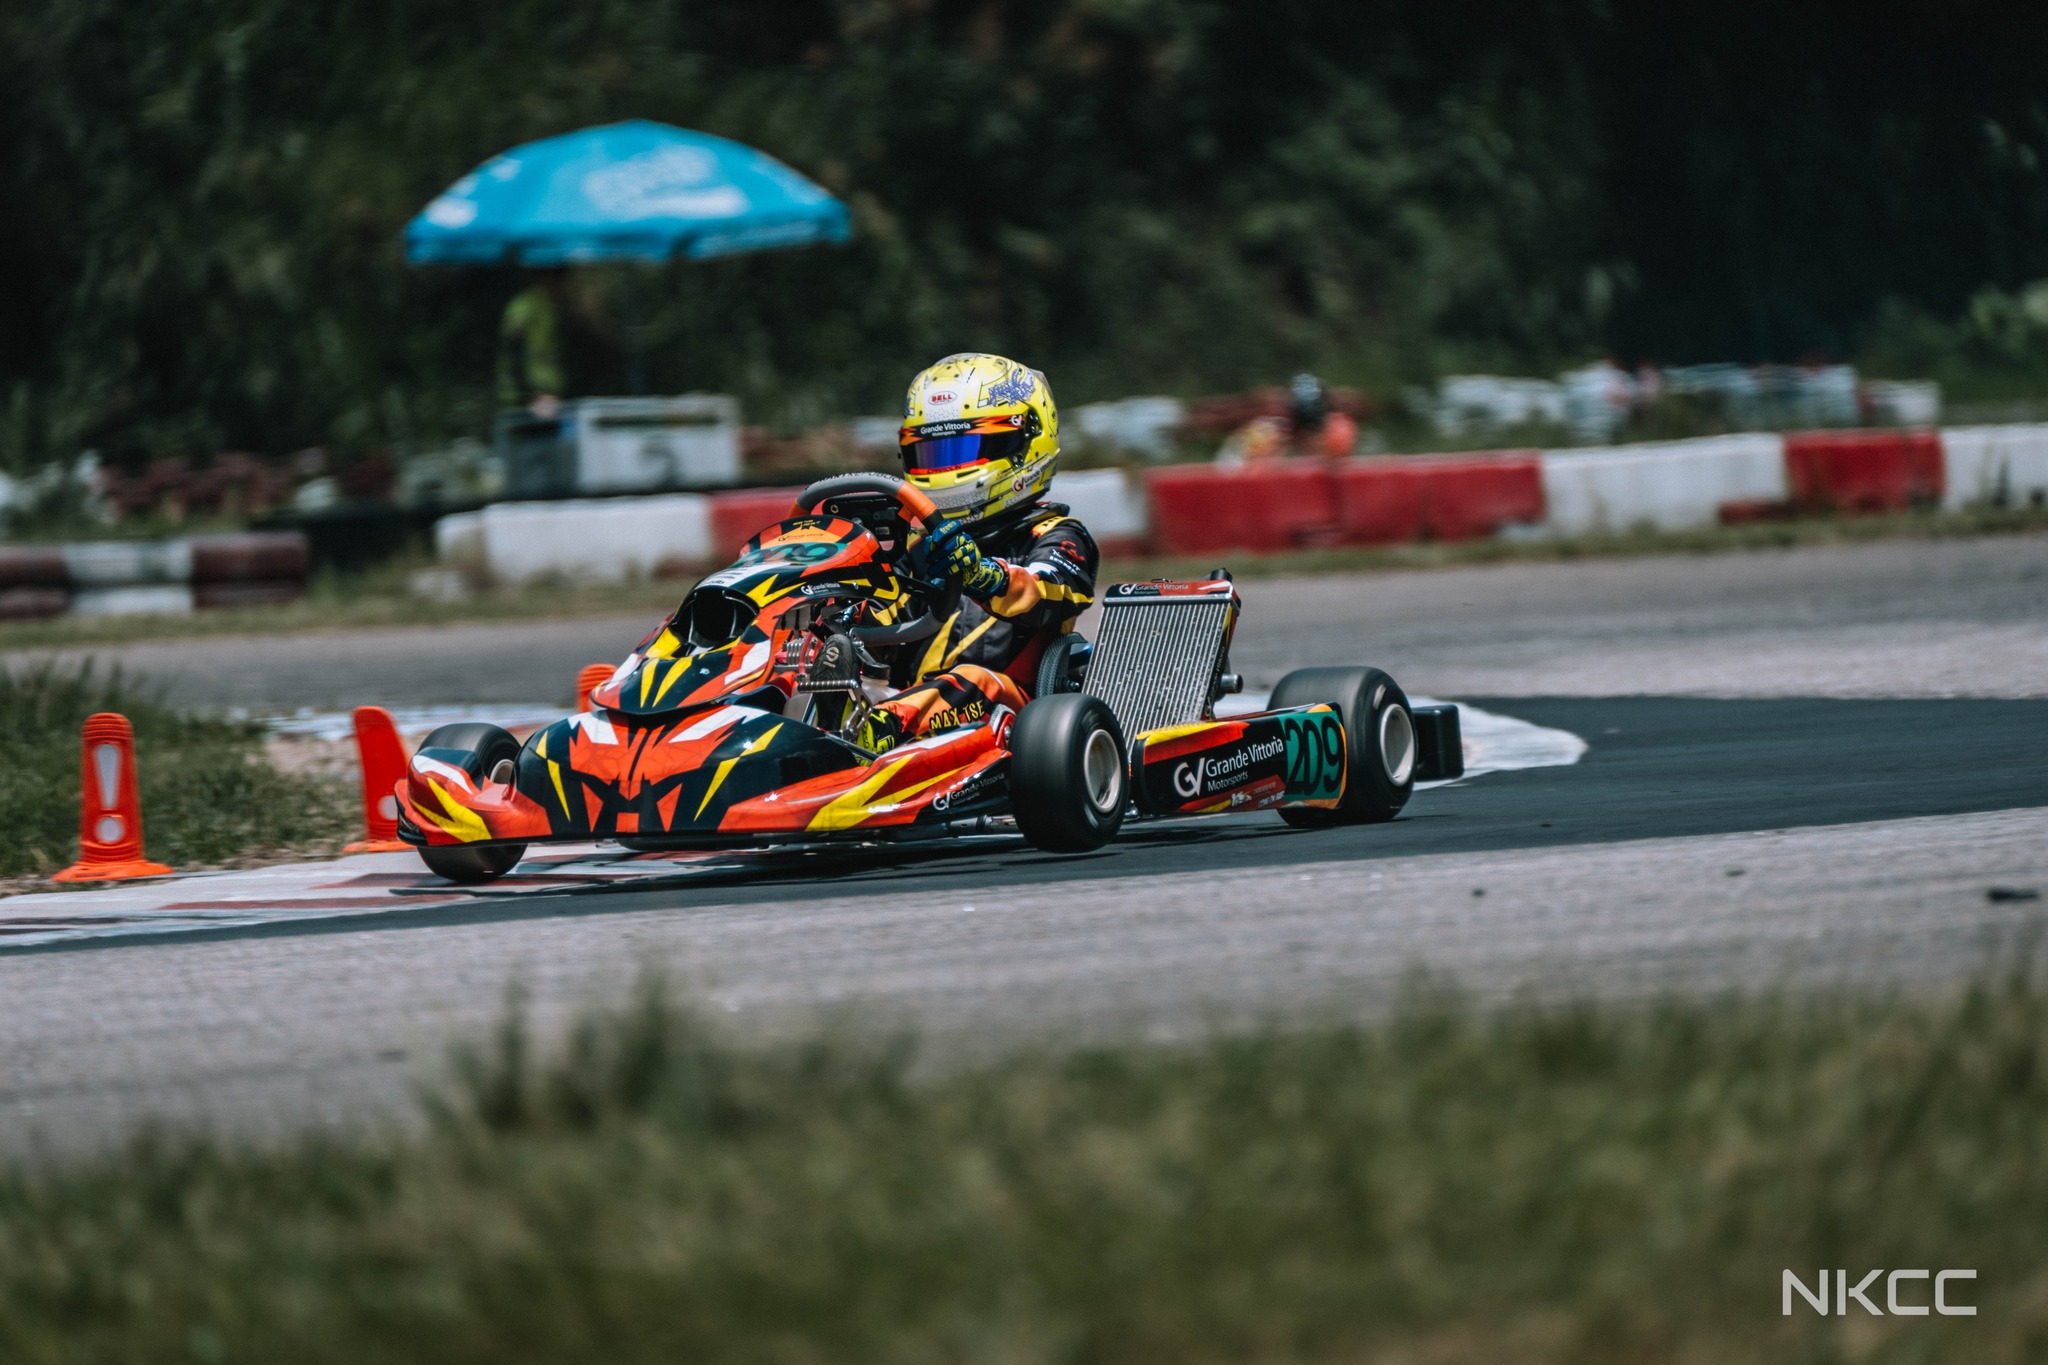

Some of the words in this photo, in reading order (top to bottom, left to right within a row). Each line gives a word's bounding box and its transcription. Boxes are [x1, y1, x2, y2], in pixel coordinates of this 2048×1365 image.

[931, 393, 953, 403] BELL
[920, 425, 944, 435] Grande
[943, 421, 971, 432] Vittoria
[931, 707, 960, 729] MAX
[963, 700, 985, 721] TSE
[1284, 716, 1345, 796] 209
[1174, 757, 1205, 798] GV
[1205, 750, 1249, 777] Grande
[1247, 736, 1284, 763] Vittoria
[950, 783, 980, 799] Grande
[1207, 771, 1249, 792] Motorsports
